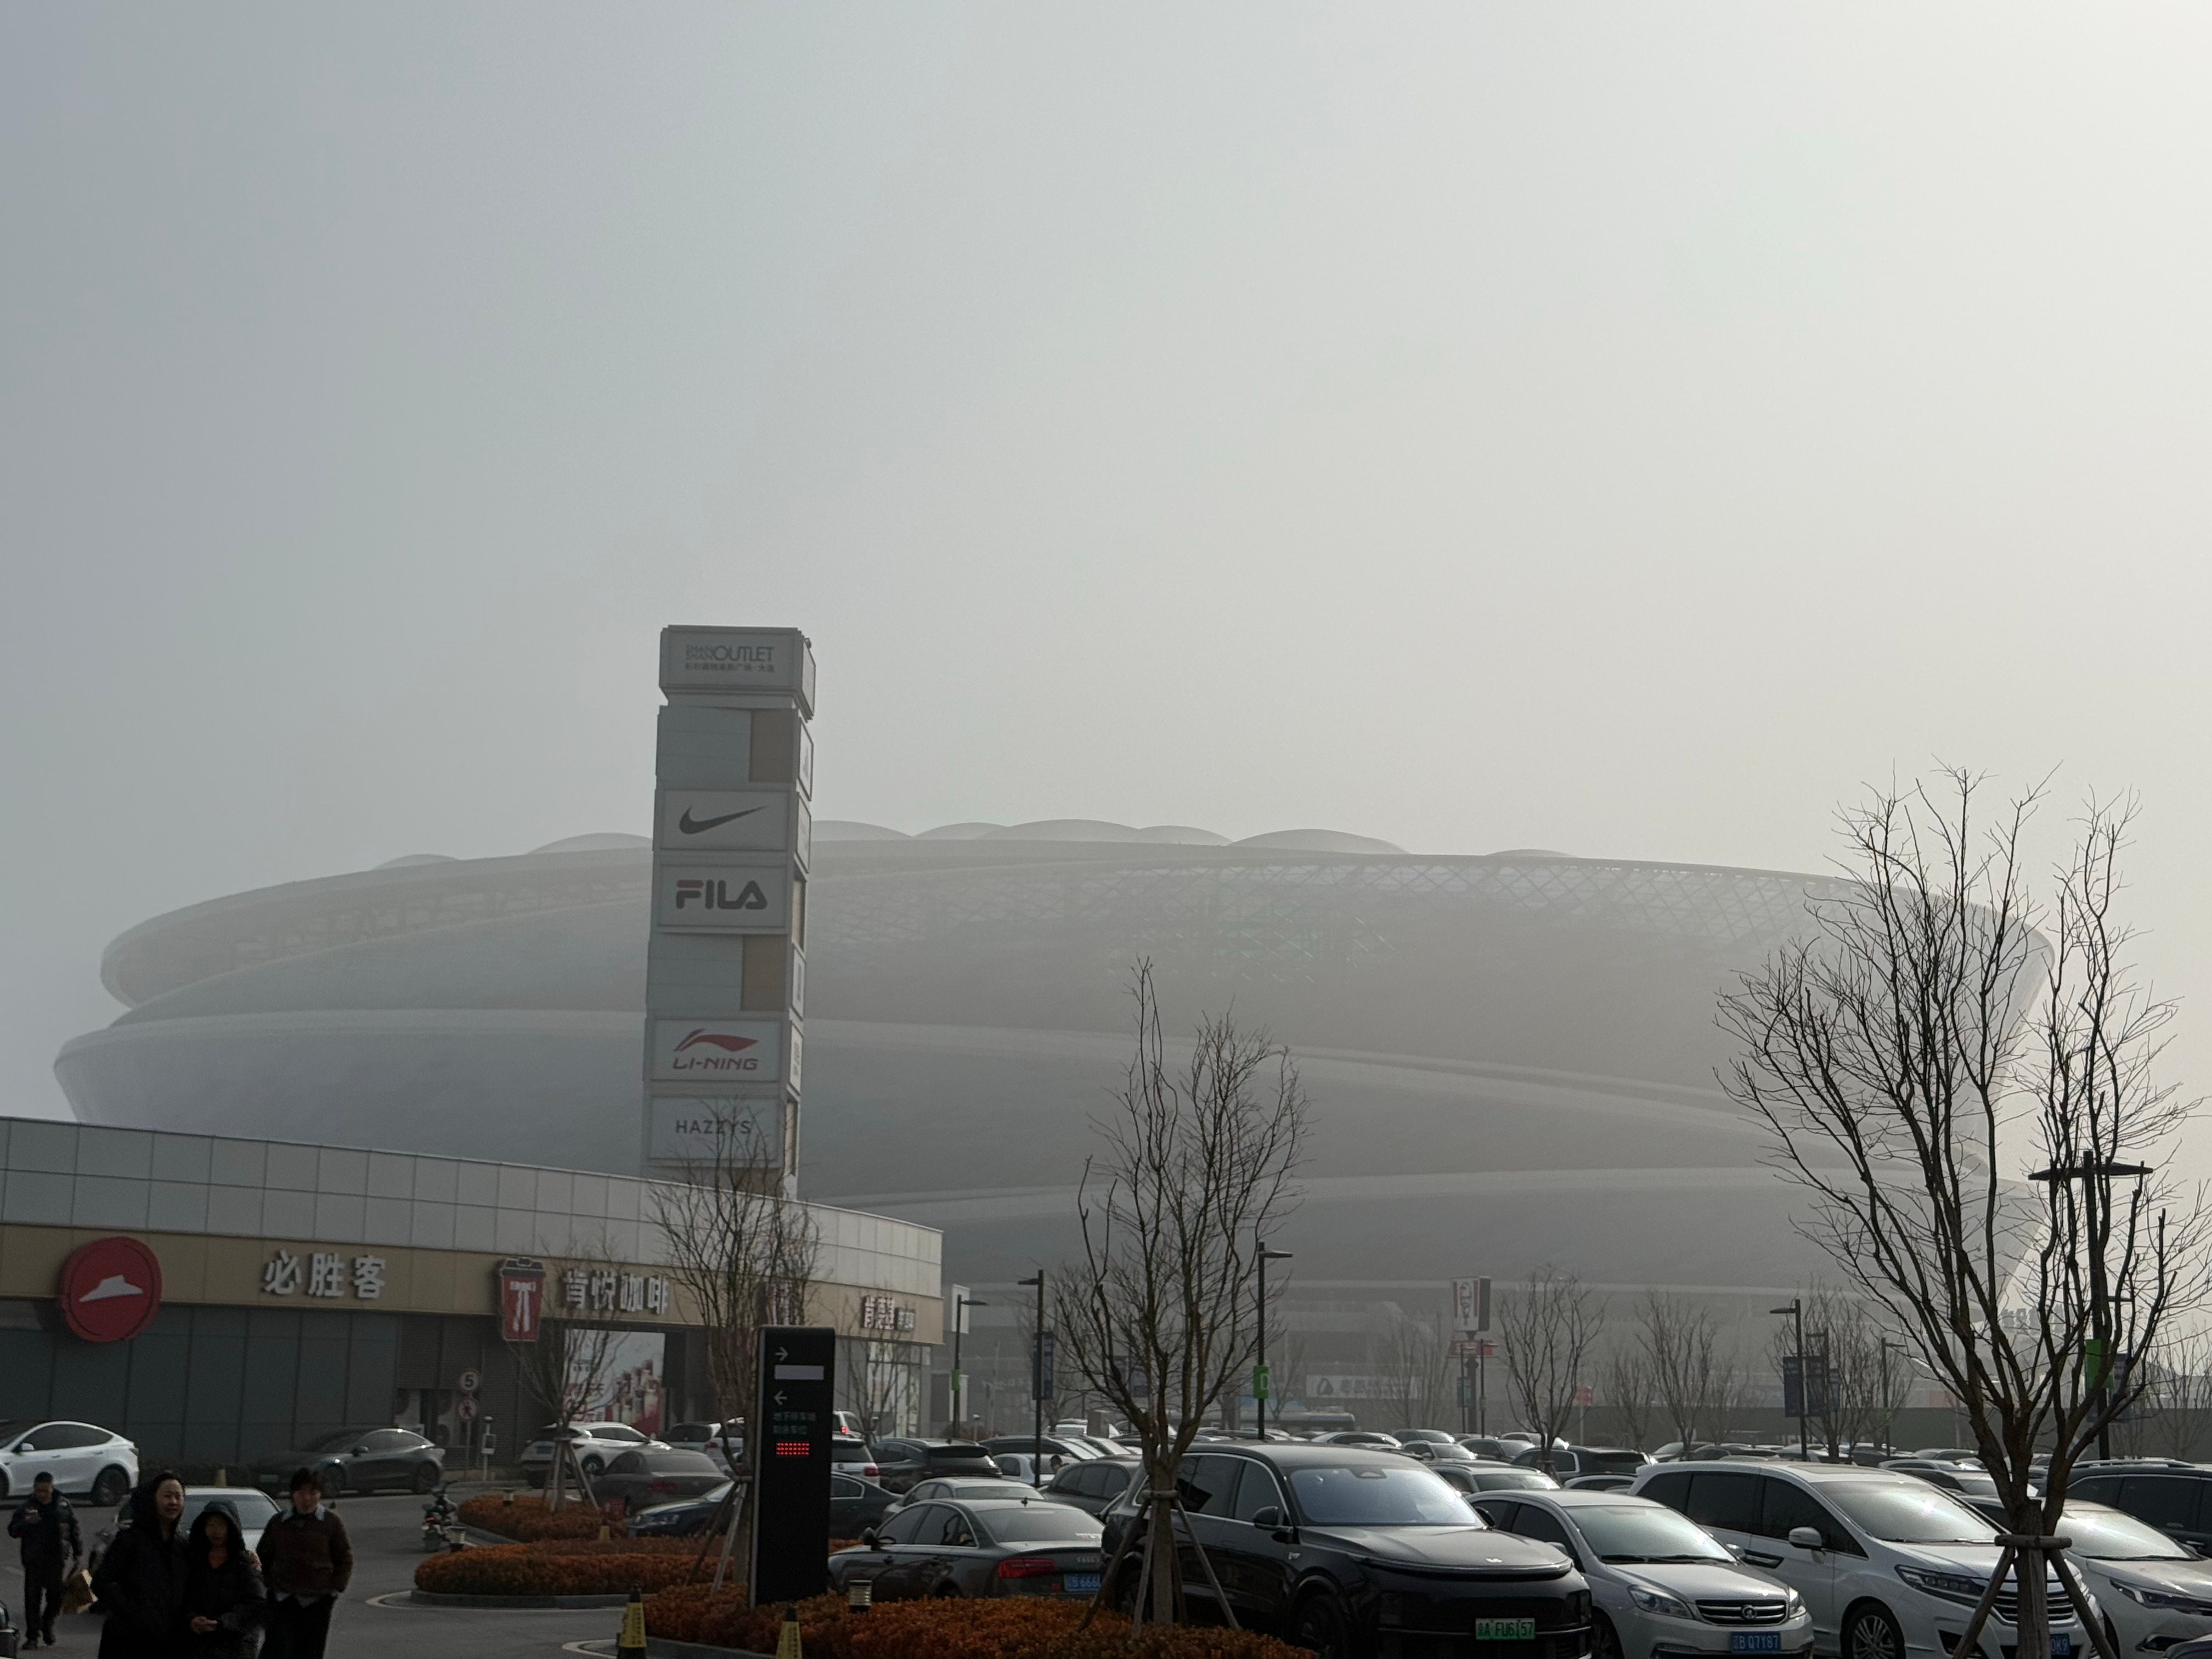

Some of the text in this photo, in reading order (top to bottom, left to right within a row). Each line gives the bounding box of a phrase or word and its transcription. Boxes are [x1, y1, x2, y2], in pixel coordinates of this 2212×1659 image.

[714, 645, 774, 662] OUTLET
[676, 879, 768, 909] FILA
[673, 1057, 759, 1071] LI-NING
[264, 1249, 385, 1299] 必胜客
[563, 1268, 669, 1314] 肯悦咖啡
[465, 1374, 474, 1387] 5
